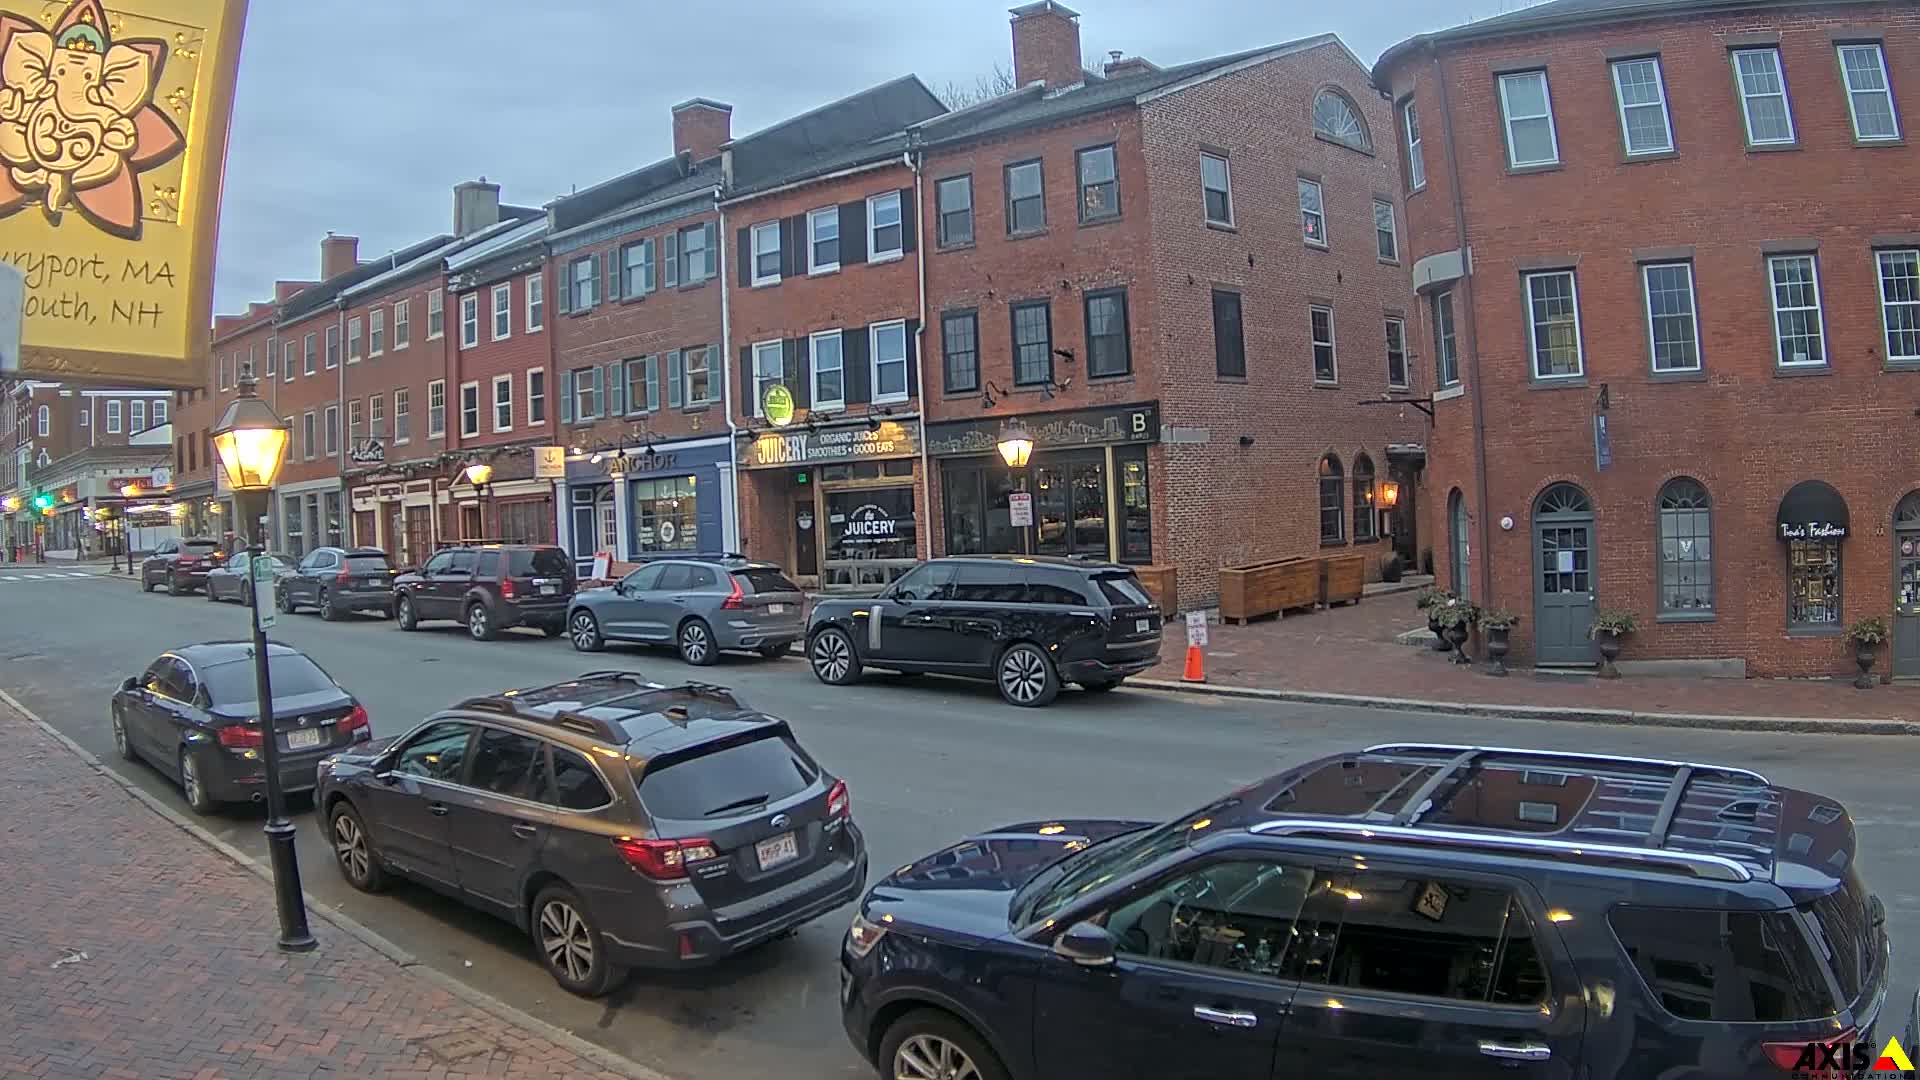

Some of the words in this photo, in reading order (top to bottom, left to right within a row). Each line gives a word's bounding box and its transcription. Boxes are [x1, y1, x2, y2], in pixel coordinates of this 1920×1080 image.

[121, 258, 175, 288] MA
[111, 300, 163, 328] NH
[1132, 412, 1146, 433] B
[757, 434, 808, 464] JUICERY
[820, 432, 852, 445] ORGANIC
[807, 445, 848, 459] SMOOTHIES
[853, 442, 875, 454] GOOD
[876, 440, 895, 453] EATS
[844, 520, 896, 536] JUICERY
